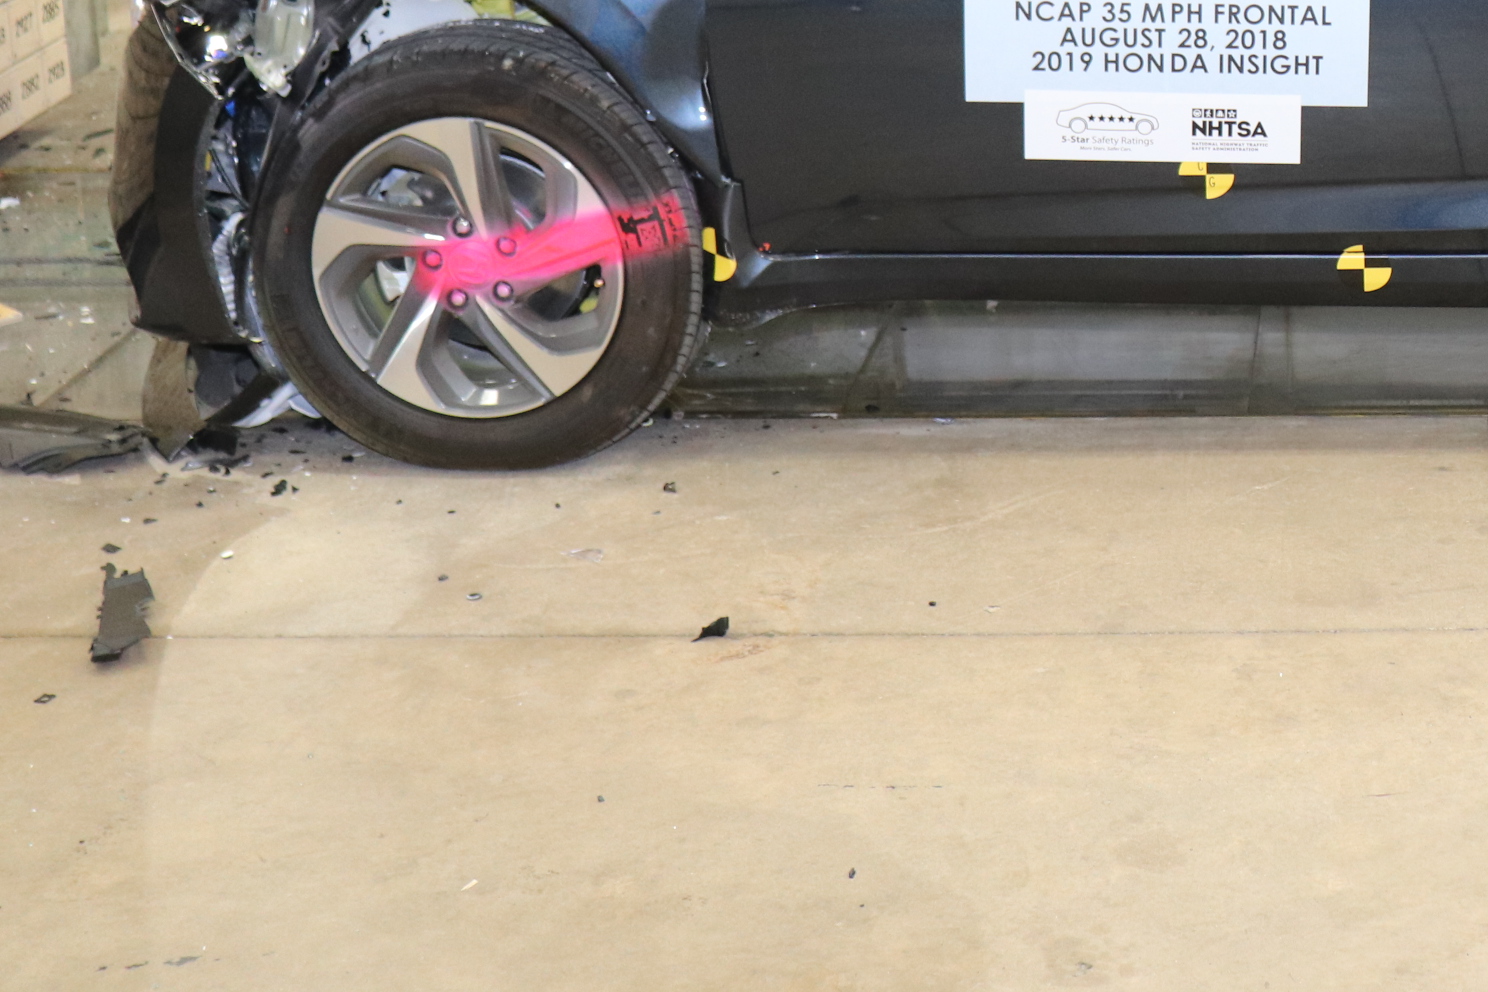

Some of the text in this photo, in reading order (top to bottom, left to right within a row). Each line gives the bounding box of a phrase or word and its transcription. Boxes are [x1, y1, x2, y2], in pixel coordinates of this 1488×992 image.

[1015, 1, 1332, 26] NCAP 35 MPH FRONTAL
[1060, 27, 1287, 52] AUGUST 28, 2018
[1032, 51, 1324, 76] 2019 HONDA INSIGHT
[1061, 135, 1154, 146] 5-Star Safety Ratings
[1192, 120, 1268, 138] NHTSA
